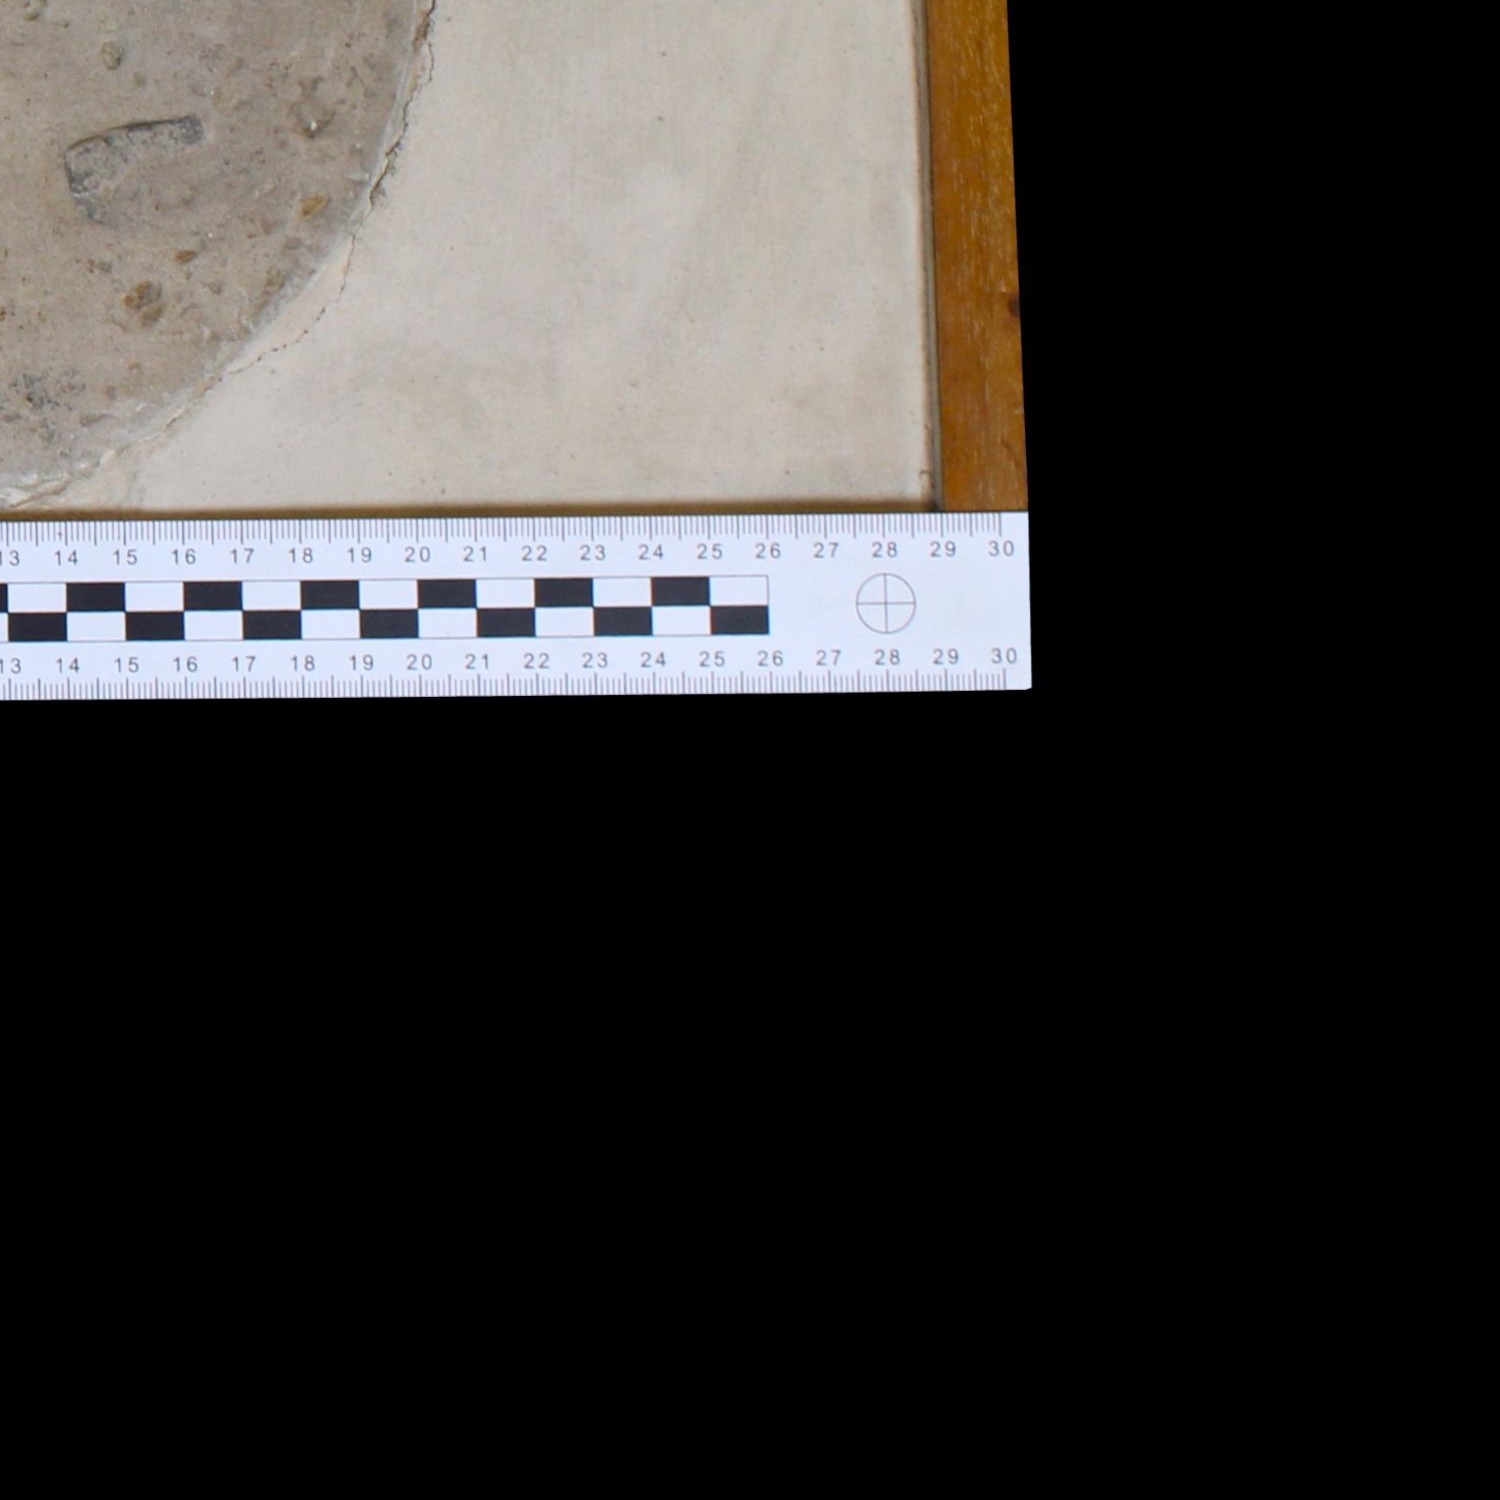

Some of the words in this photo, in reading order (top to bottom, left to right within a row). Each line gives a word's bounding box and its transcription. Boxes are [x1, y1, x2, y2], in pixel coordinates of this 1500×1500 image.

[55, 550, 78, 565] 14
[114, 549, 137, 565] 15
[172, 548, 196, 564] 16
[232, 548, 254, 563] 17
[290, 548, 313, 563] 18
[348, 547, 372, 562] 19
[405, 547, 430, 562] 20
[464, 546, 486, 562] 21
[522, 545, 546, 561] 22
[581, 545, 605, 560] 23
[639, 544, 663, 560] 24
[698, 544, 722, 559] 25
[756, 543, 780, 558] 26
[814, 542, 838, 558] 27
[872, 542, 897, 557] 28
[931, 541, 956, 557] 29
[989, 540, 1014, 556] 30
[57, 658, 79, 672] 14
[115, 657, 138, 673] 15
[174, 656, 198, 672] 16
[233, 656, 256, 672] 17
[292, 655, 314, 671] 18
[350, 655, 373, 670] 19
[408, 654, 432, 670] 20
[466, 654, 488, 669] 21
[524, 653, 549, 669] 22
[583, 652, 607, 668] 23
[642, 652, 666, 667] 24
[700, 652, 724, 667] 25
[758, 651, 783, 666] 26
[817, 650, 840, 666] 27
[876, 650, 900, 665] 28
[934, 649, 958, 664] 29
[992, 648, 1016, 664] 30
